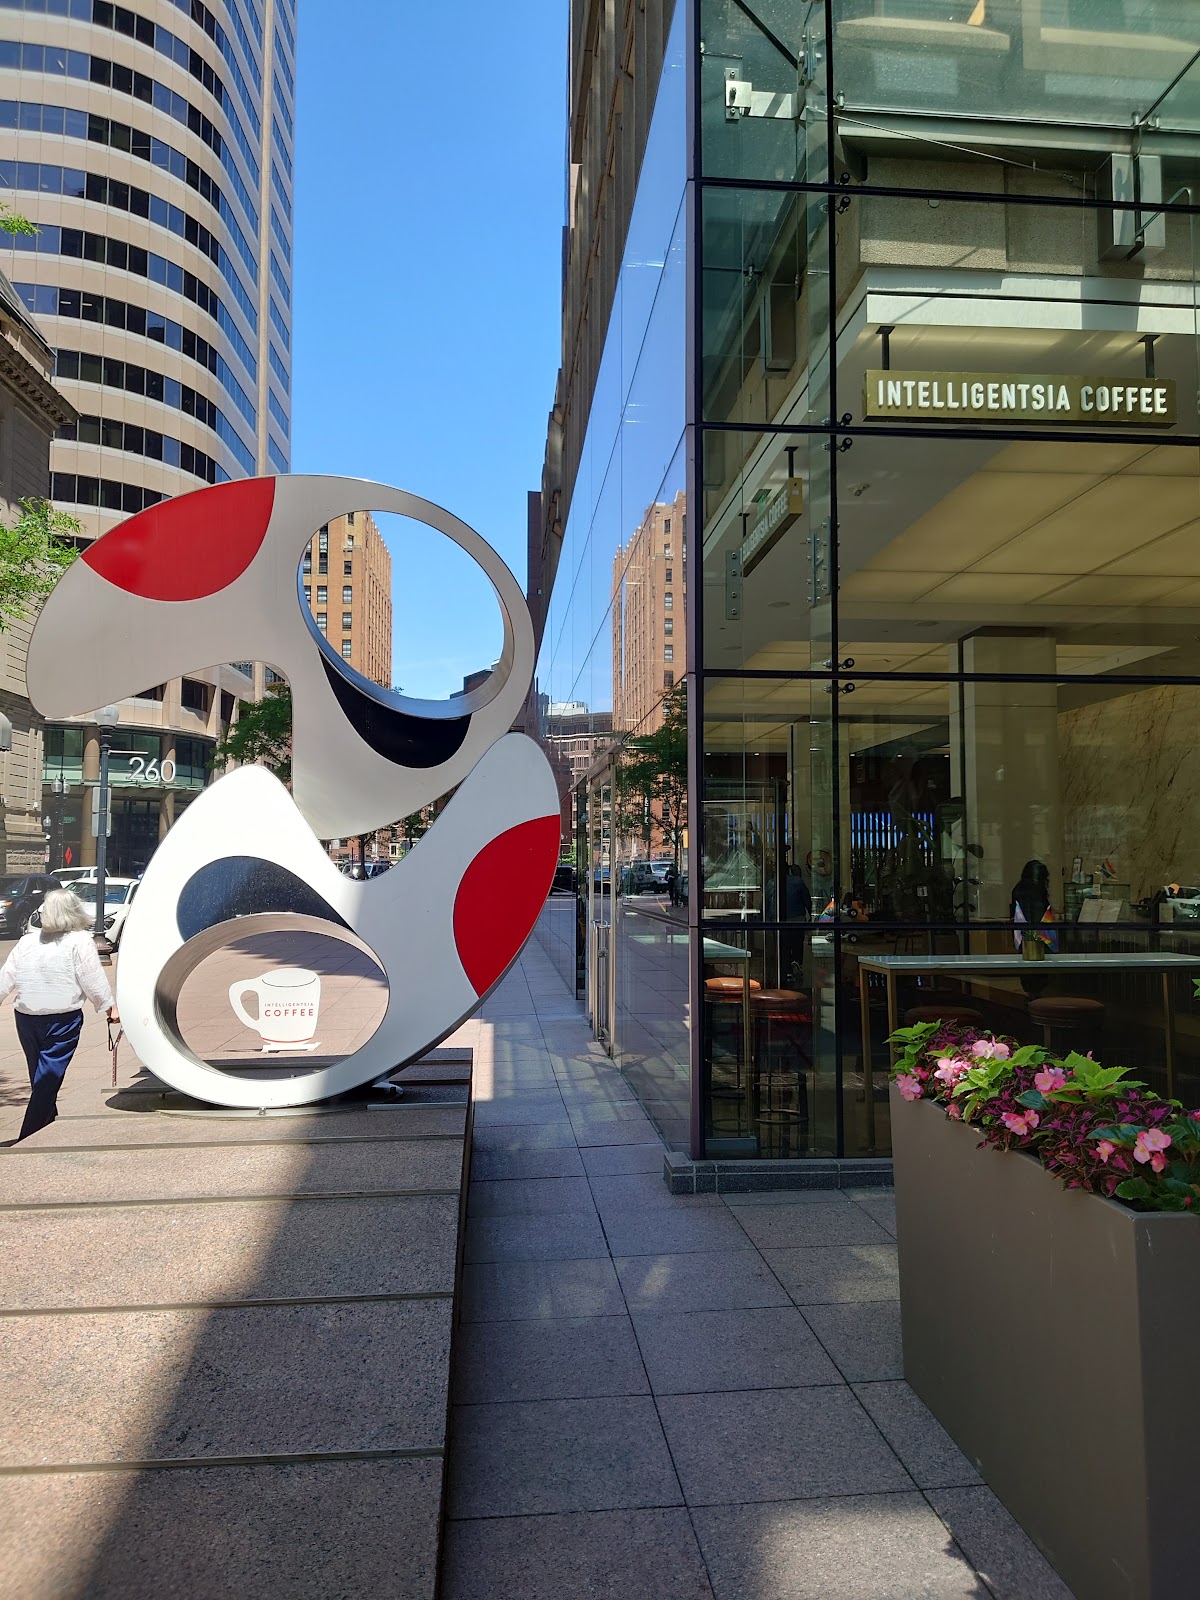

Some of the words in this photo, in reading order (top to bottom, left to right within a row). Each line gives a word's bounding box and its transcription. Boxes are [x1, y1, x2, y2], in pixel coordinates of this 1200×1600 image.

[877, 379, 1071, 411] INTELLIGENTSIA
[1080, 385, 1168, 414] COFFEE
[128, 756, 176, 782] 260
[264, 1008, 314, 1017] COFFEE
